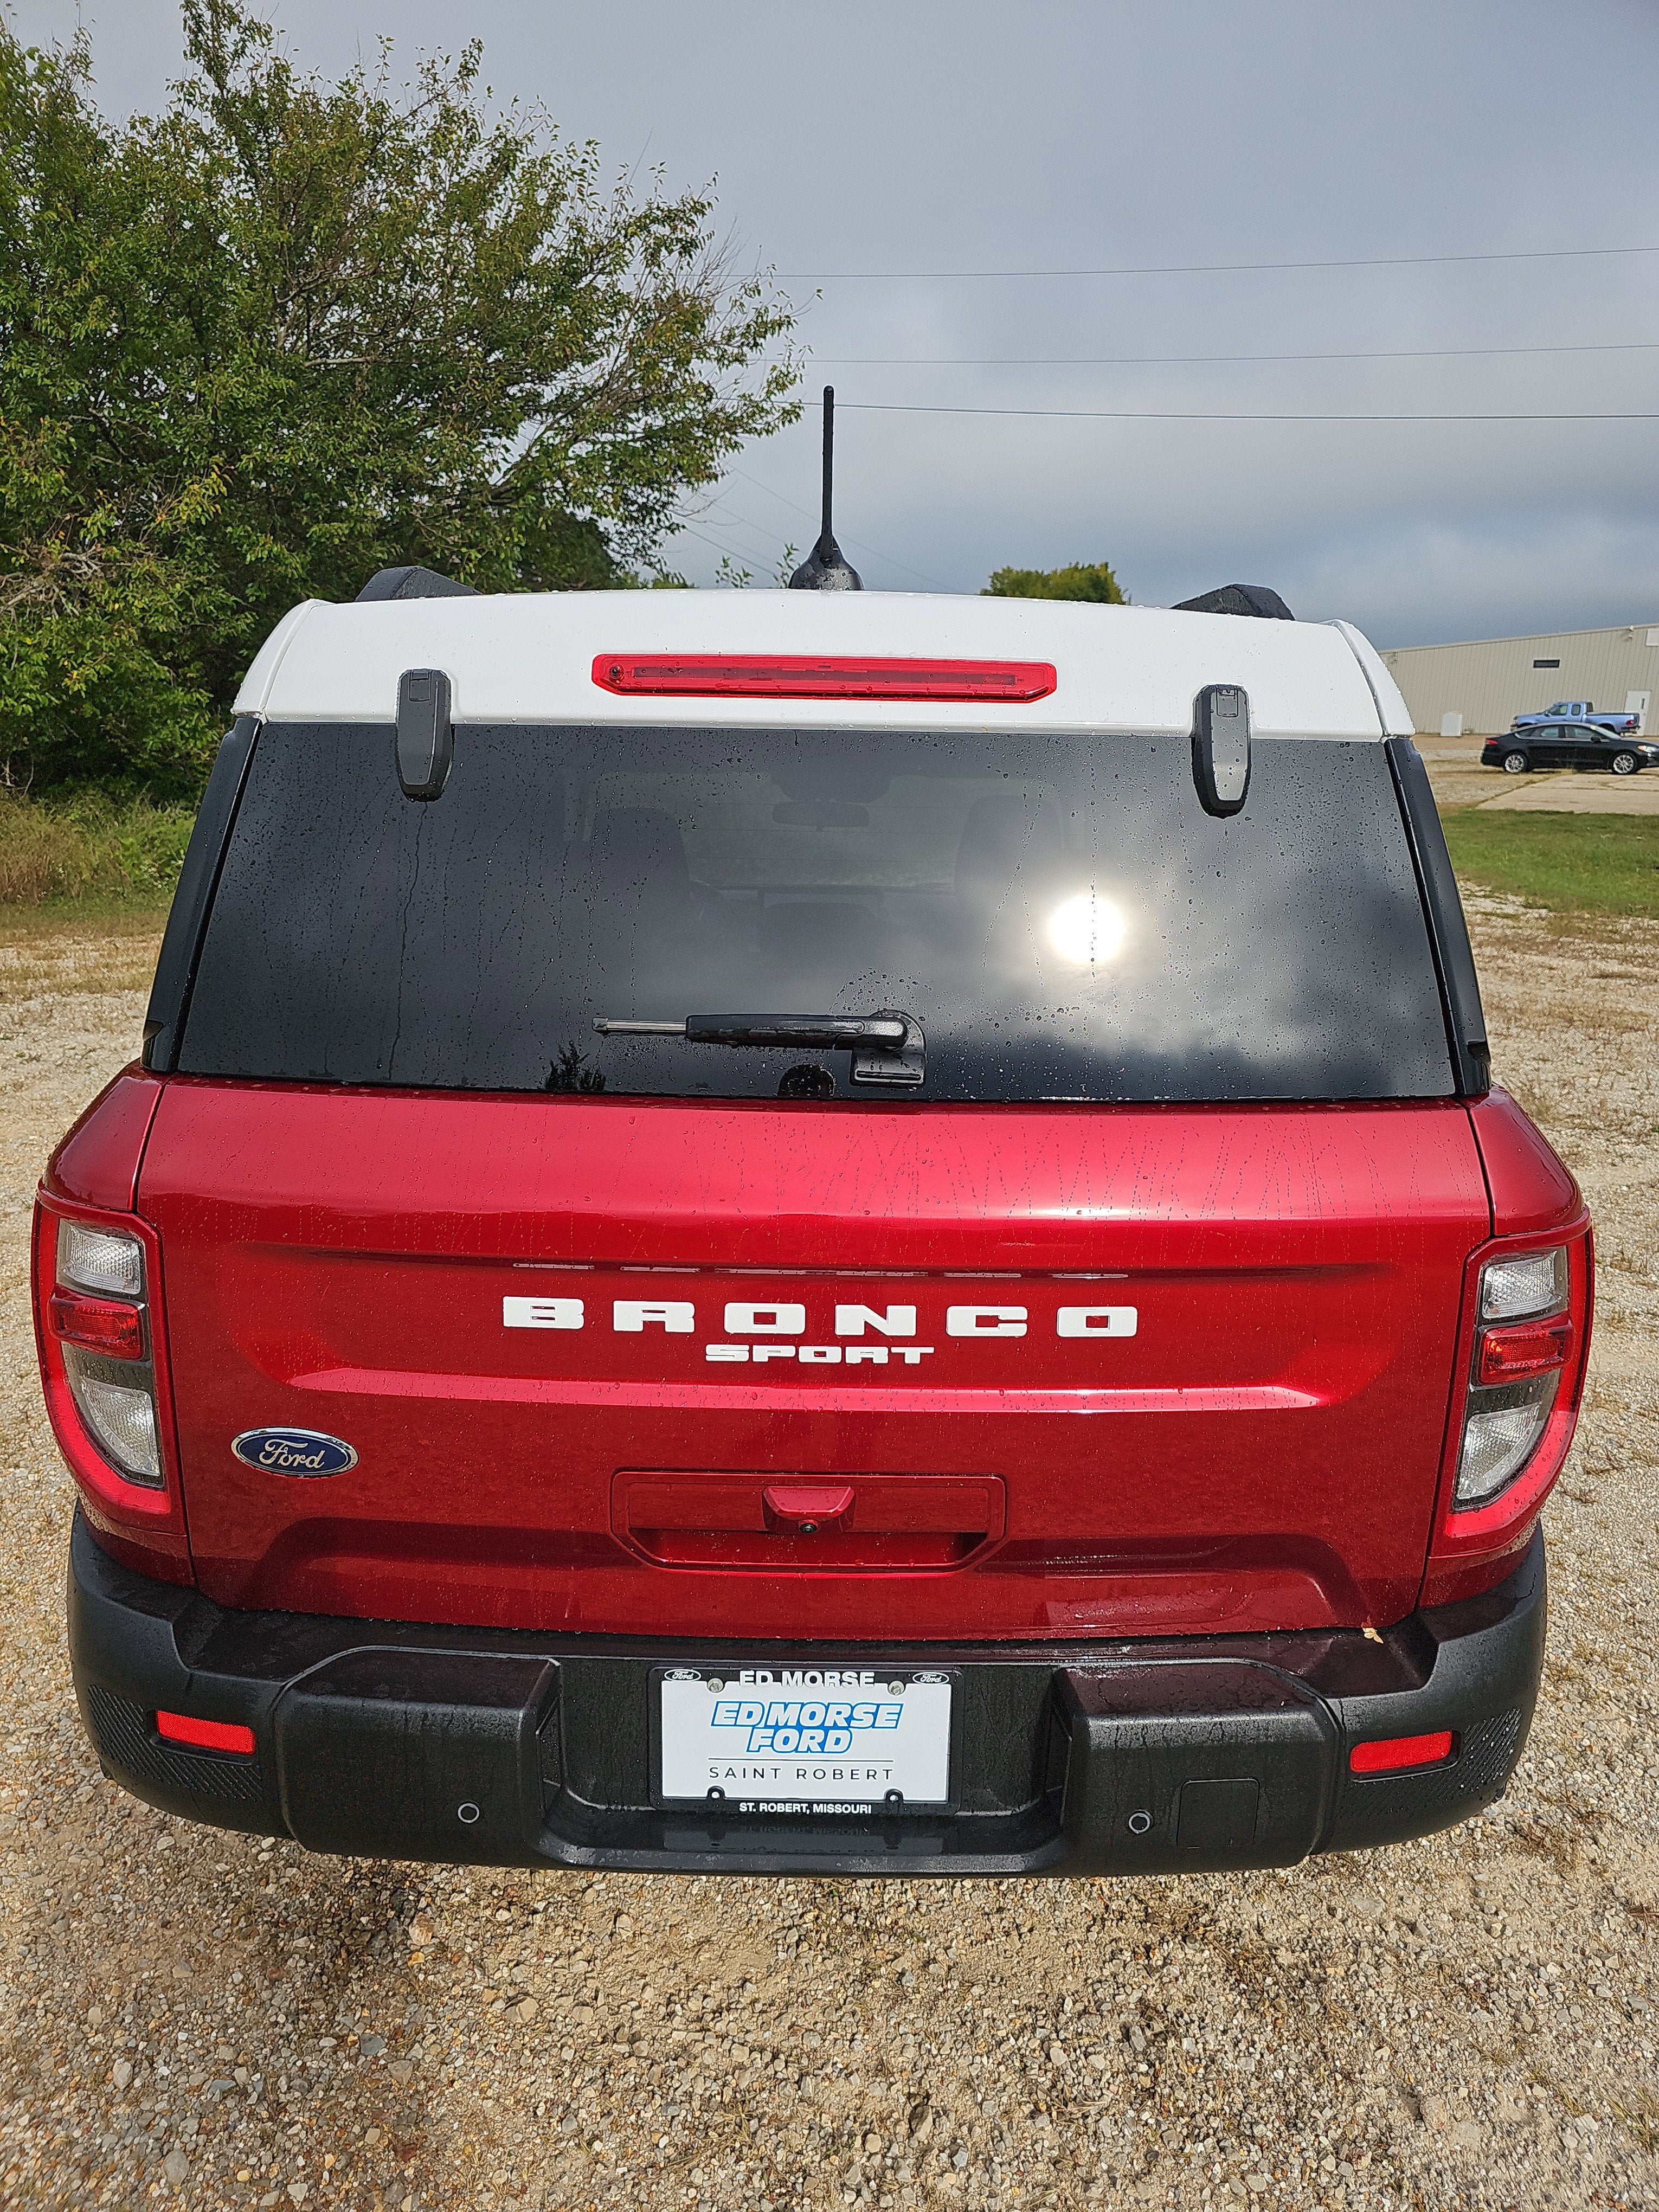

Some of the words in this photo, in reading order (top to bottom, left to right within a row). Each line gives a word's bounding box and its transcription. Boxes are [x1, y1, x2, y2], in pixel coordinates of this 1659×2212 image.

[503, 1296, 1138, 1338] BRONCO
[705, 1344, 935, 1364] SPORT
[259, 1439, 326, 1469] Ford
[672, 1670, 694, 1680] Ford
[739, 1670, 777, 1687] ED
[782, 1671, 875, 1688] MORSE
[920, 1674, 942, 1683] Ford
[711, 1701, 766, 1728] ED
[763, 1702, 904, 1729] MORSE
[746, 1729, 853, 1753] FORD
[709, 1767, 781, 1779] SAINT
[796, 1768, 893, 1780] ROBERT
[739, 1803, 757, 1812] ST.
[759, 1803, 811, 1814] ROBERT,
[813, 1804, 872, 1814] MISSOURI
